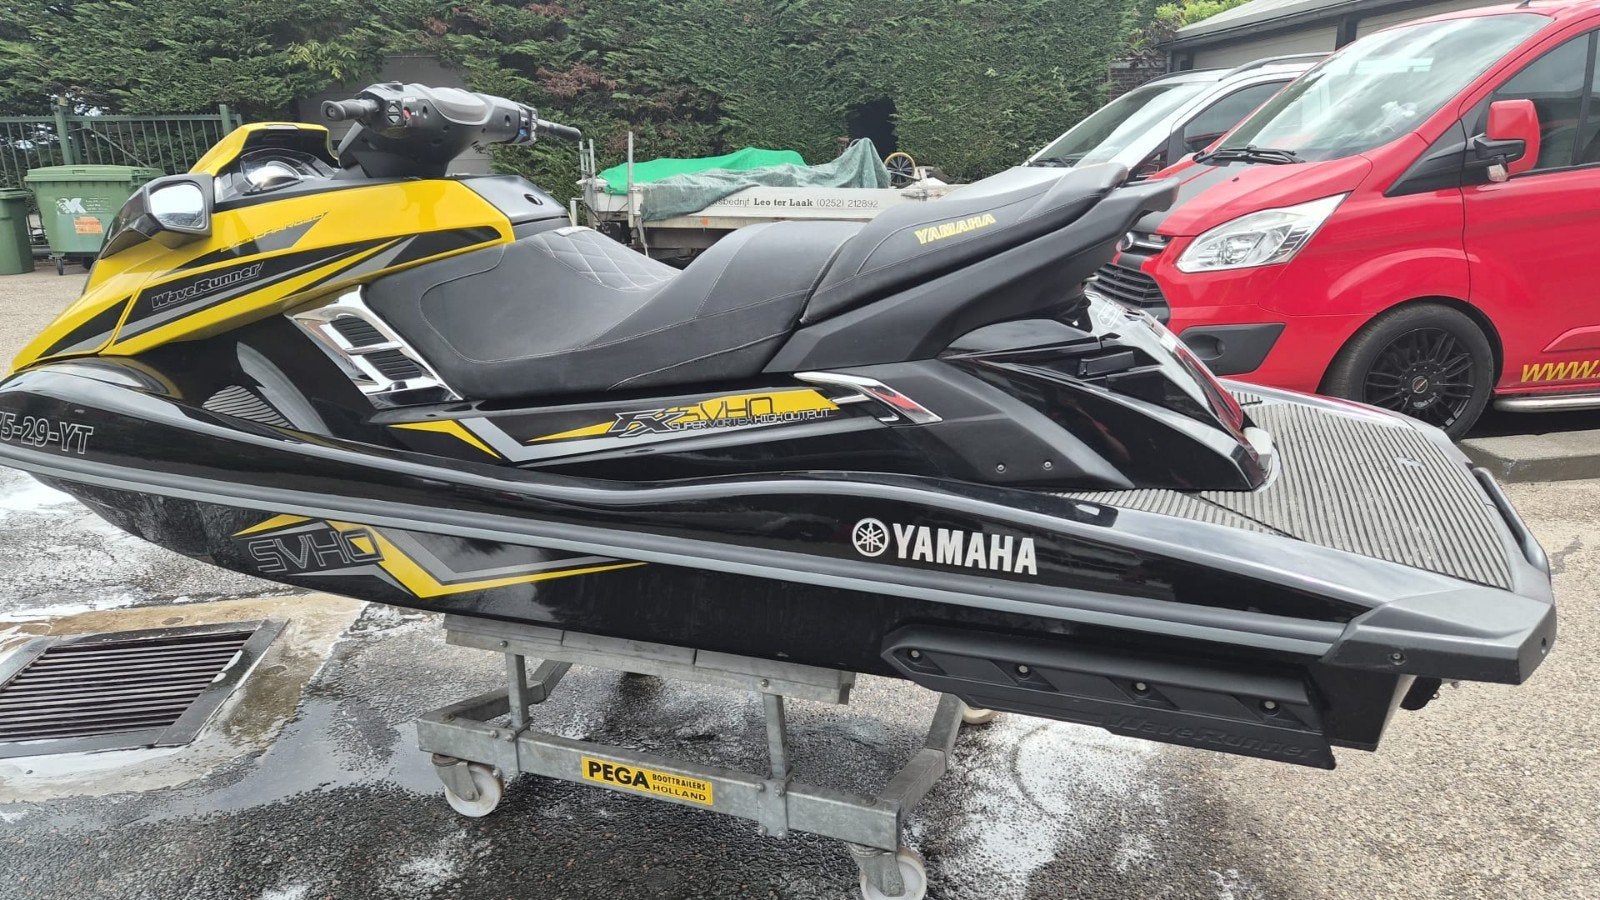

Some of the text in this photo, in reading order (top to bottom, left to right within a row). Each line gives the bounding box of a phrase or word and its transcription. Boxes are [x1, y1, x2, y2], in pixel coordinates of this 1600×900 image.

[753, 197, 771, 206] Leo
[773, 198, 787, 207] ter
[789, 198, 813, 207] Laak
[816, 198, 844, 208] (0252)
[847, 199, 879, 208] 212892
[914, 213, 997, 245] YAMAHA
[151, 261, 264, 311] WaveRunner
[1521, 360, 1600, 383] www.
[0, 410, 94, 455] 5-29-YT
[609, 408, 685, 438] FX
[671, 419, 707, 431] SUPER
[754, 411, 785, 425] HIGH
[784, 408, 831, 422] OUTPUT
[248, 528, 385, 573] SVHO
[893, 523, 1038, 576] YAMAHA
[588, 760, 706, 791] PEGA BOOTTRAILERS
[652, 784, 706, 801] HOLLAND
